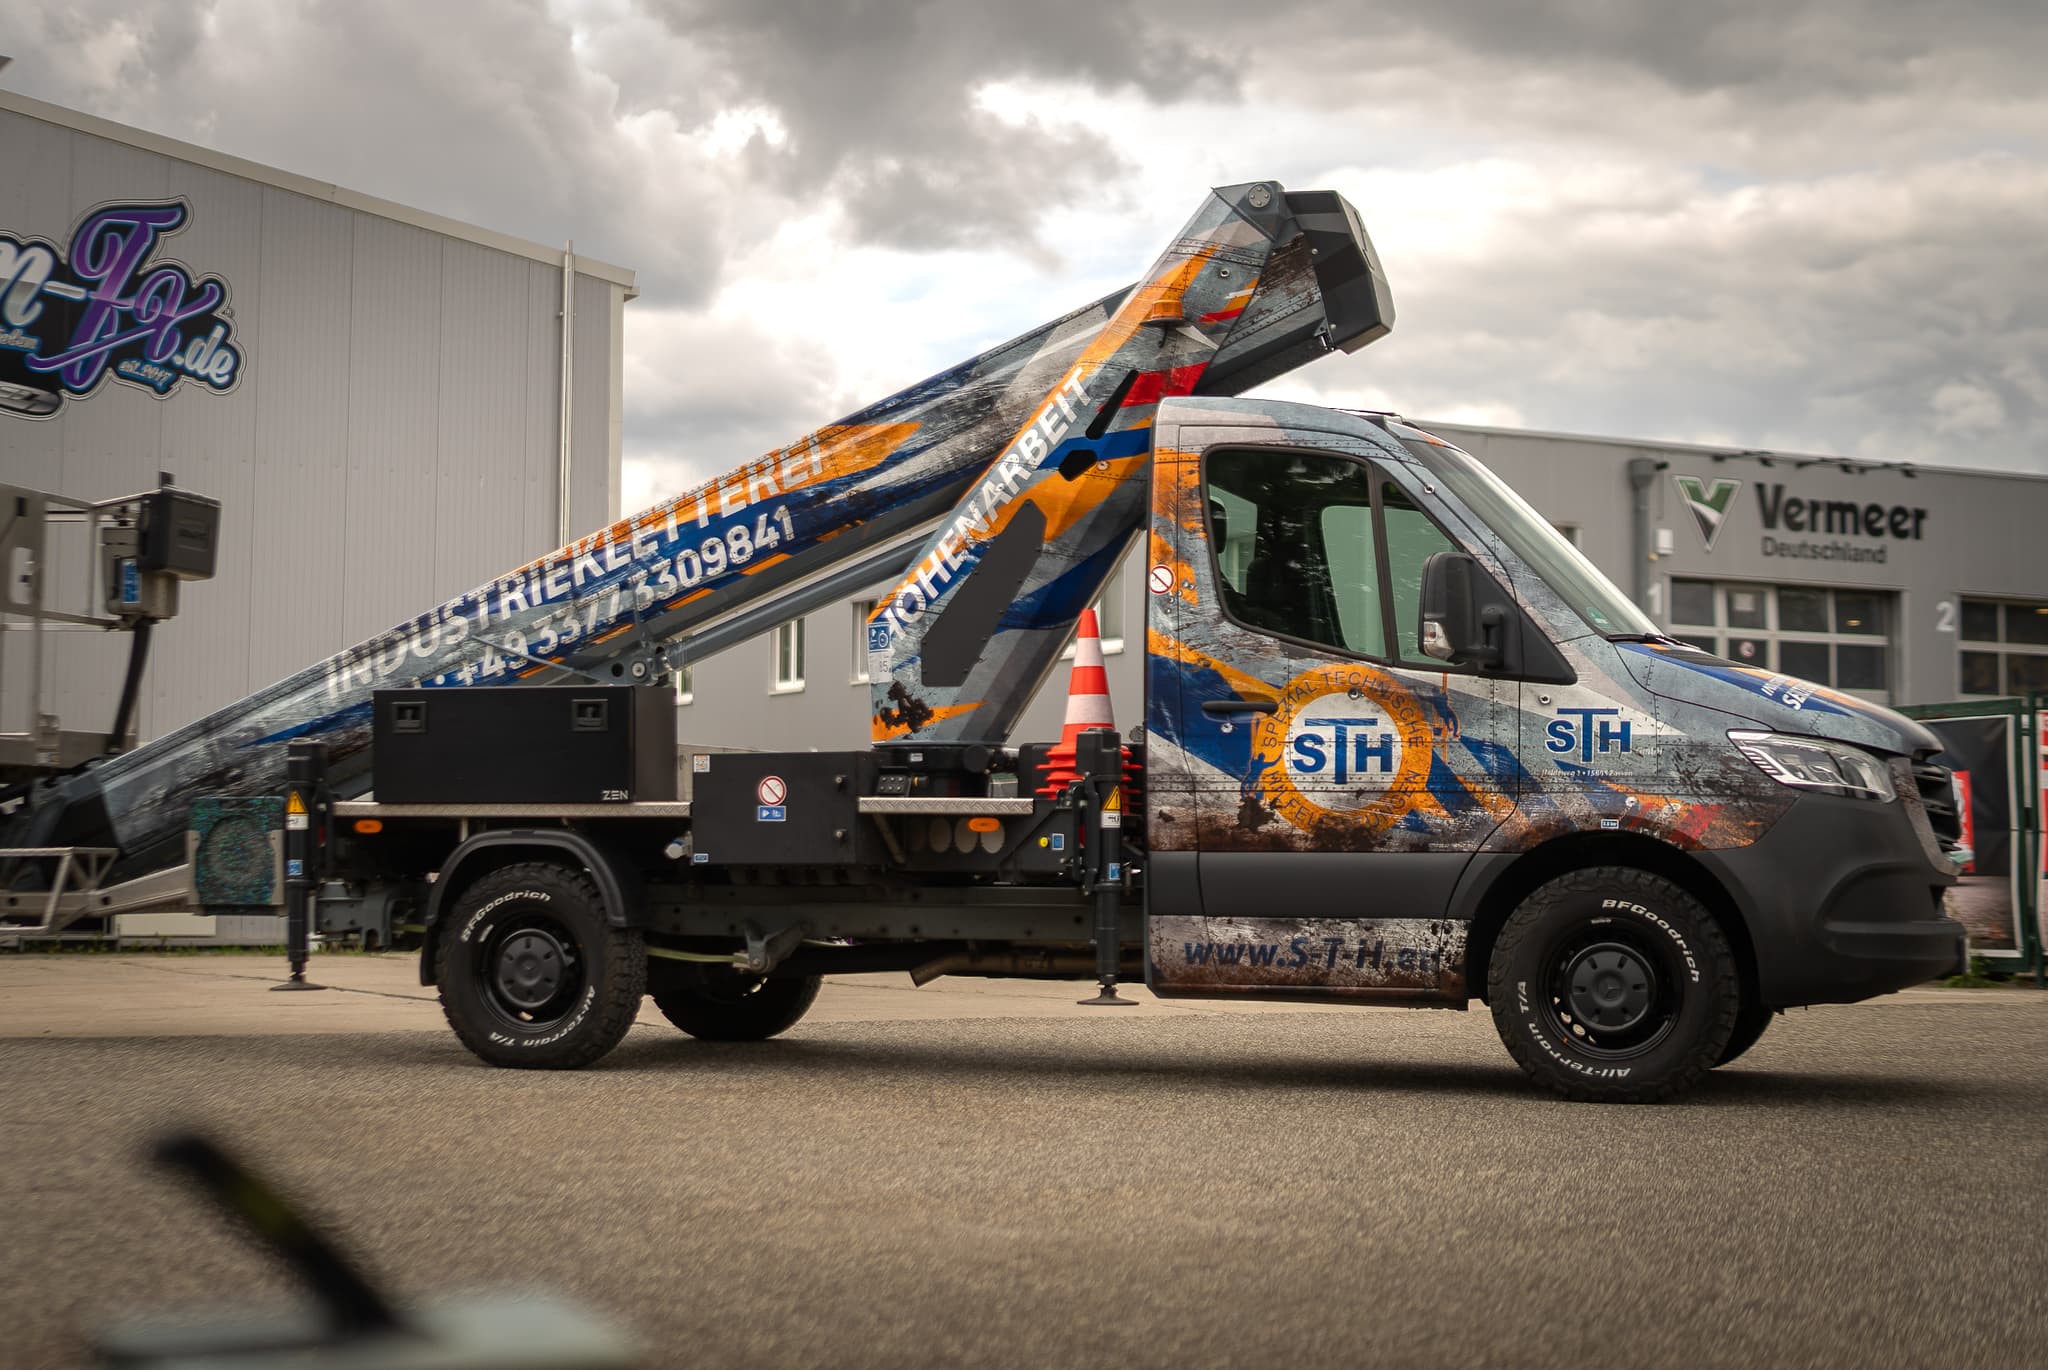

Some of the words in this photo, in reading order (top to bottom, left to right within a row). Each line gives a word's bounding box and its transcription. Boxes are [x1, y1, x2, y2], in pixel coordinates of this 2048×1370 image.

[1754, 482, 1928, 541] Vermeer
[327, 432, 825, 699] INDUSTRIEKLETTEREI
[1761, 535, 1888, 565] Deutschland
[532, 582, 622, 656] 3377
[629, 505, 797, 611] 3309841
[1647, 582, 1663, 616] 1
[1936, 601, 1956, 633] 2
[1263, 679, 1319, 749] SPEZIAL
[1320, 670, 1425, 749] TECHNISCHE
[1544, 707, 1632, 763] STH
[1292, 718, 1393, 785] STH
[602, 790, 629, 800] ZEN
[460, 889, 552, 943] BFGoodrich
[1602, 898, 1701, 983] BFGoodrich
[522, 984, 597, 1048] All-Terrain
[1516, 980, 1530, 1014] T/A
[487, 1031, 516, 1047] T/A
[1528, 1021, 1632, 1078] All-Terrain
